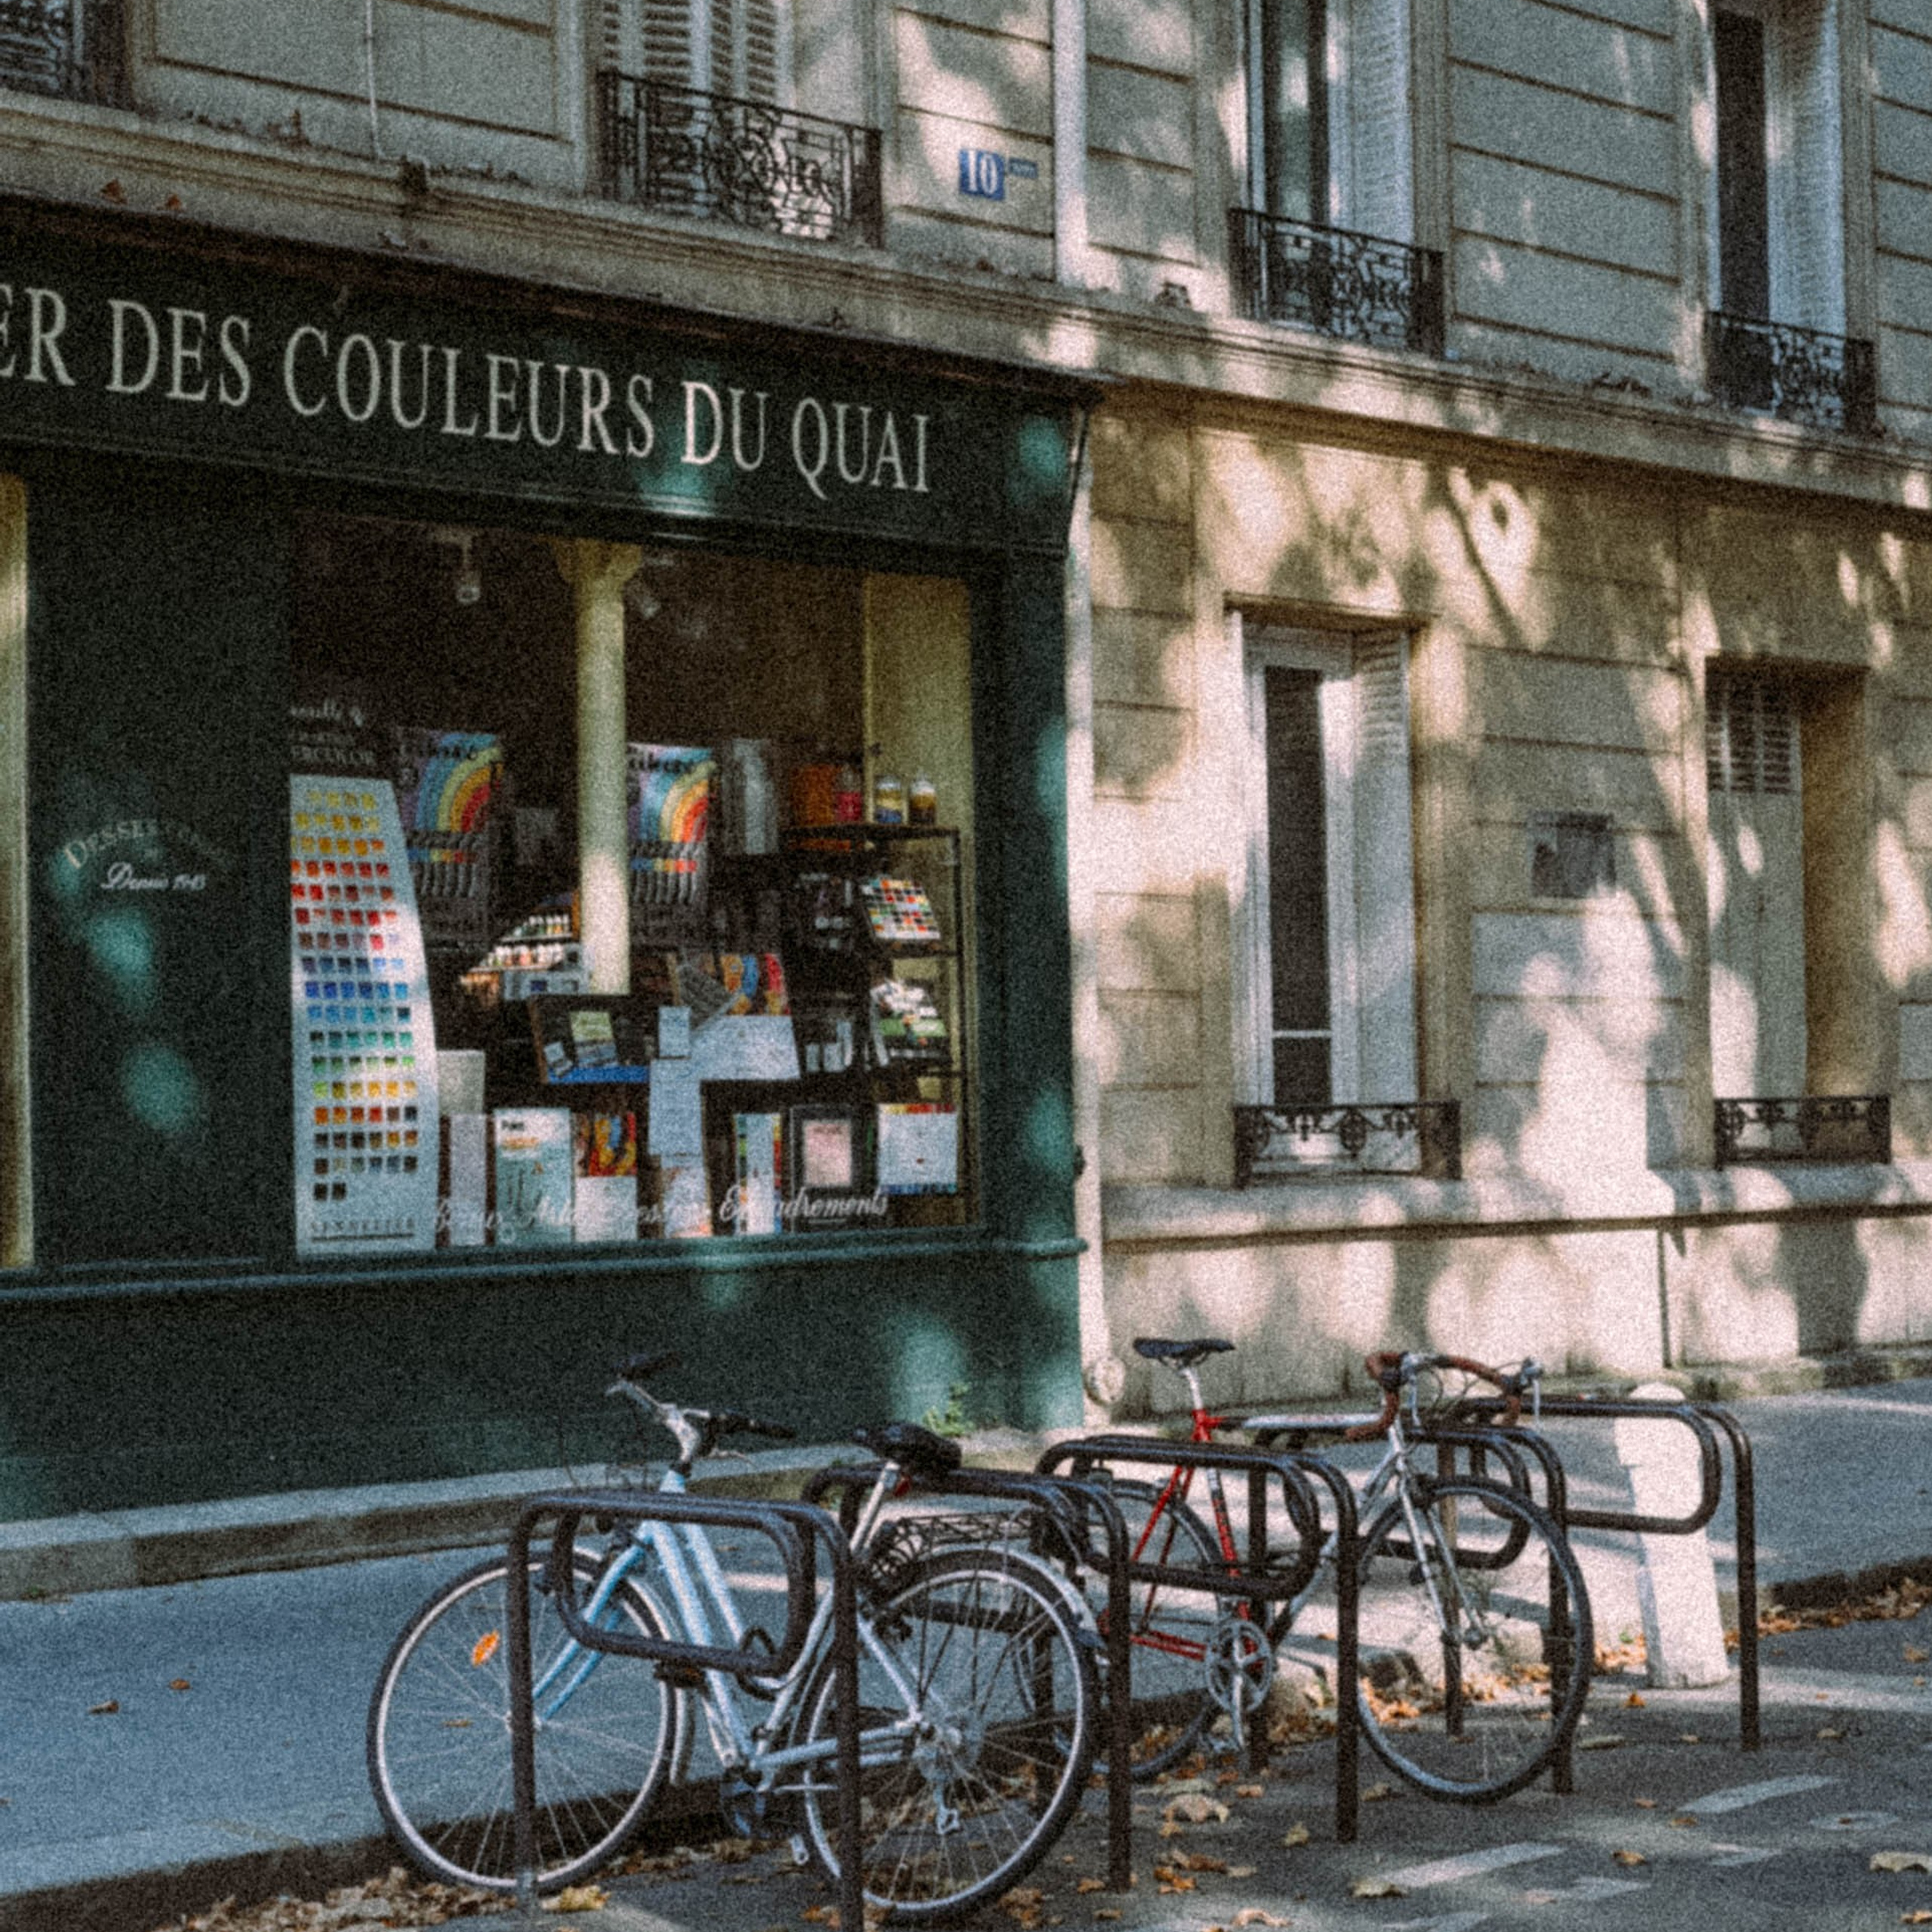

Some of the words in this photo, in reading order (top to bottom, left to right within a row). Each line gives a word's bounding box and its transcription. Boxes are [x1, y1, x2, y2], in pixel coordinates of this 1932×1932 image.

[968, 150, 998, 194] 10
[106, 300, 251, 408] DES
[283, 325, 654, 459] COULEURS
[681, 380, 768, 472] DU
[791, 397, 928, 500] QUAI
